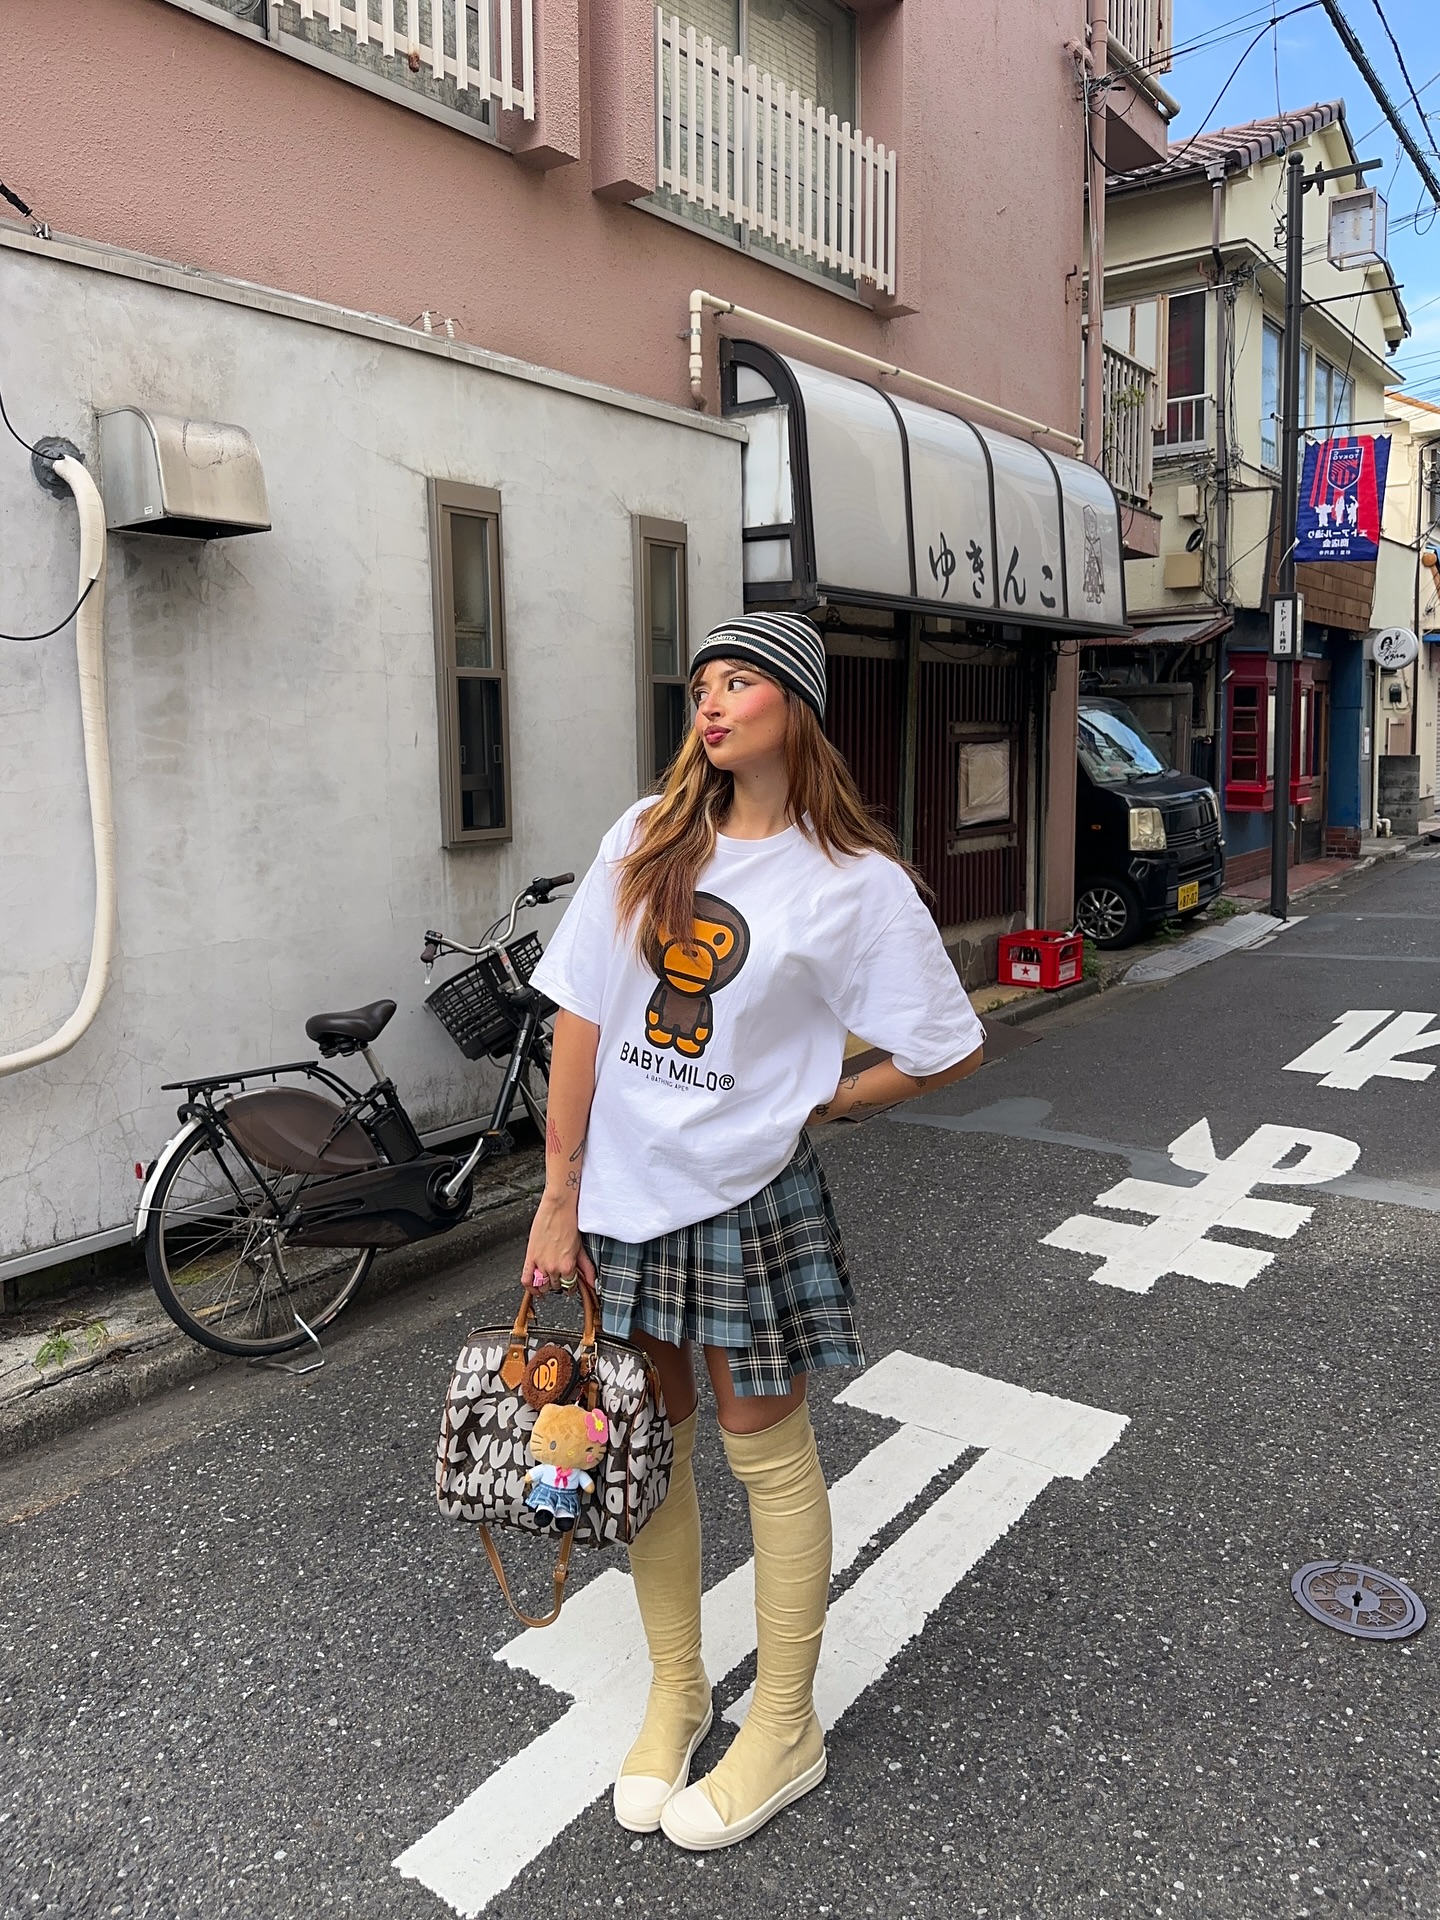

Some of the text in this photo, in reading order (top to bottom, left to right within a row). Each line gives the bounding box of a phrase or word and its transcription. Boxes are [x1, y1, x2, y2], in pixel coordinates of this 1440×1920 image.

[928, 531, 1056, 609] ゆきんこ
[1279, 601, 1288, 652] エトアール通り
[620, 1041, 664, 1074] BABY
